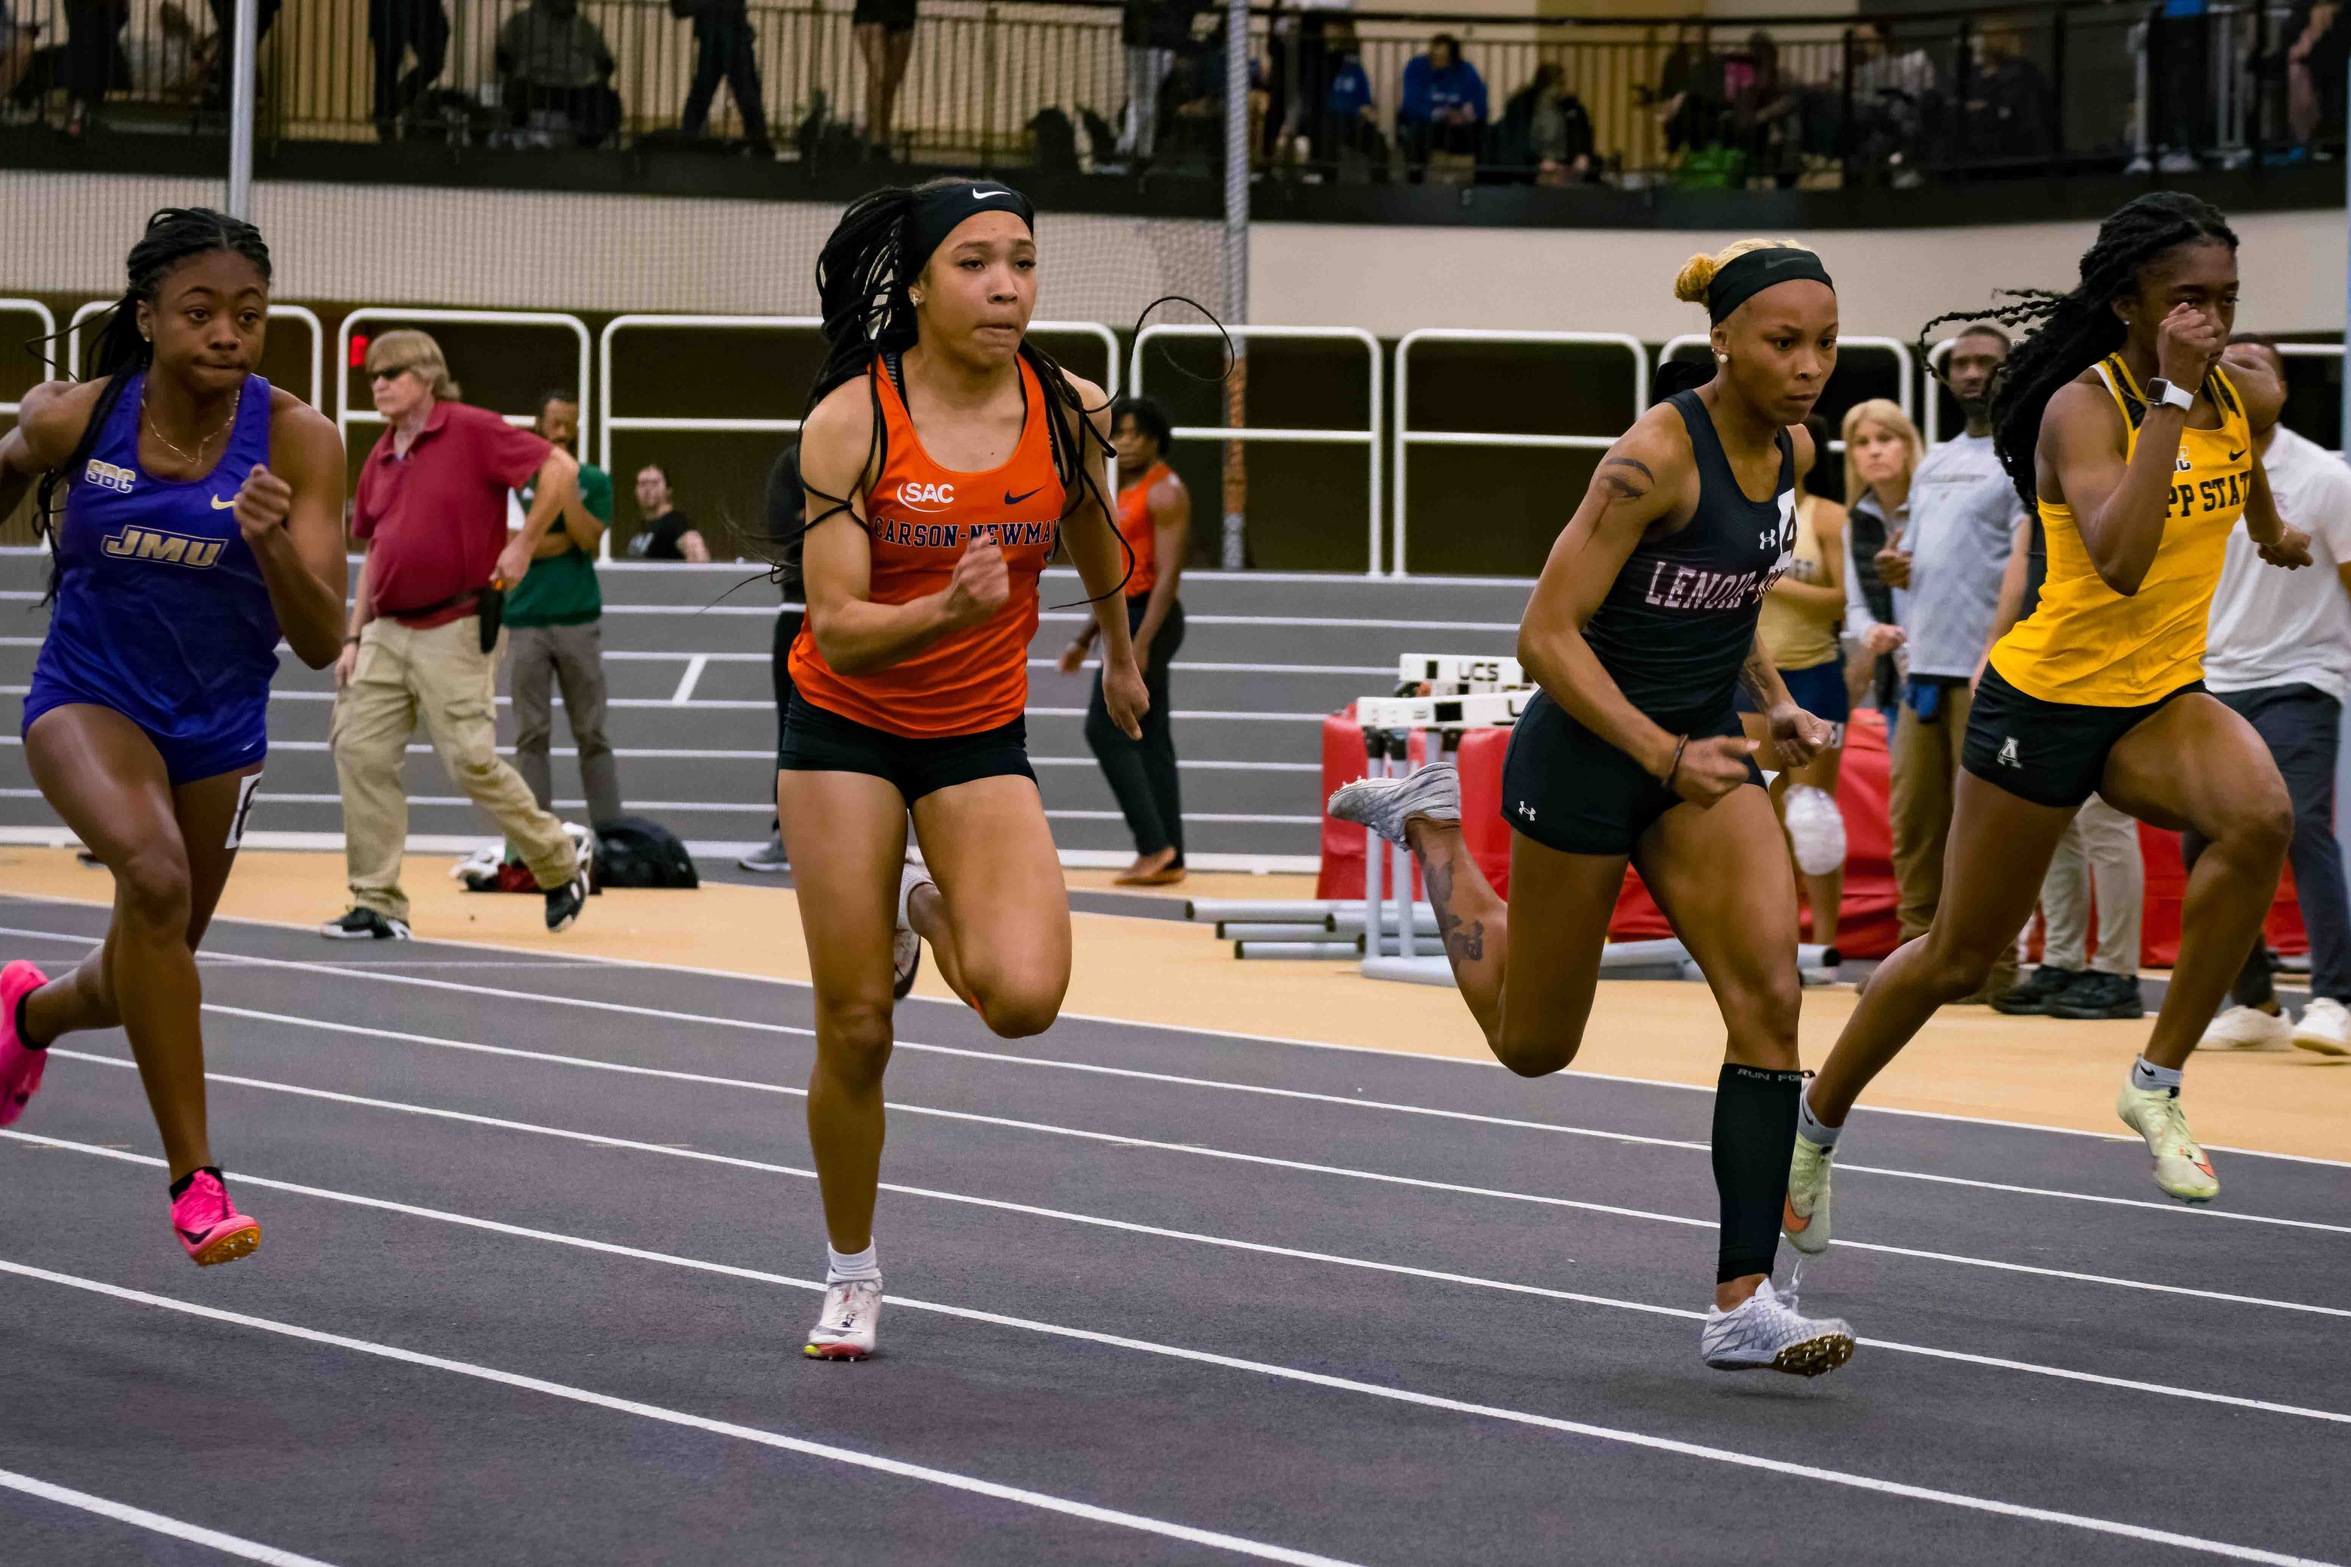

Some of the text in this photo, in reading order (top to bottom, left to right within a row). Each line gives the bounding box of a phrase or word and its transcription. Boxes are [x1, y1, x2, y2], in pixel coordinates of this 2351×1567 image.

[85, 459, 136, 493] SBC
[904, 482, 955, 504] SAC
[2165, 471, 2250, 518] PP STAT
[104, 528, 224, 567] JMU
[1457, 662, 1499, 682] UCS
[1997, 736, 2022, 769] A
